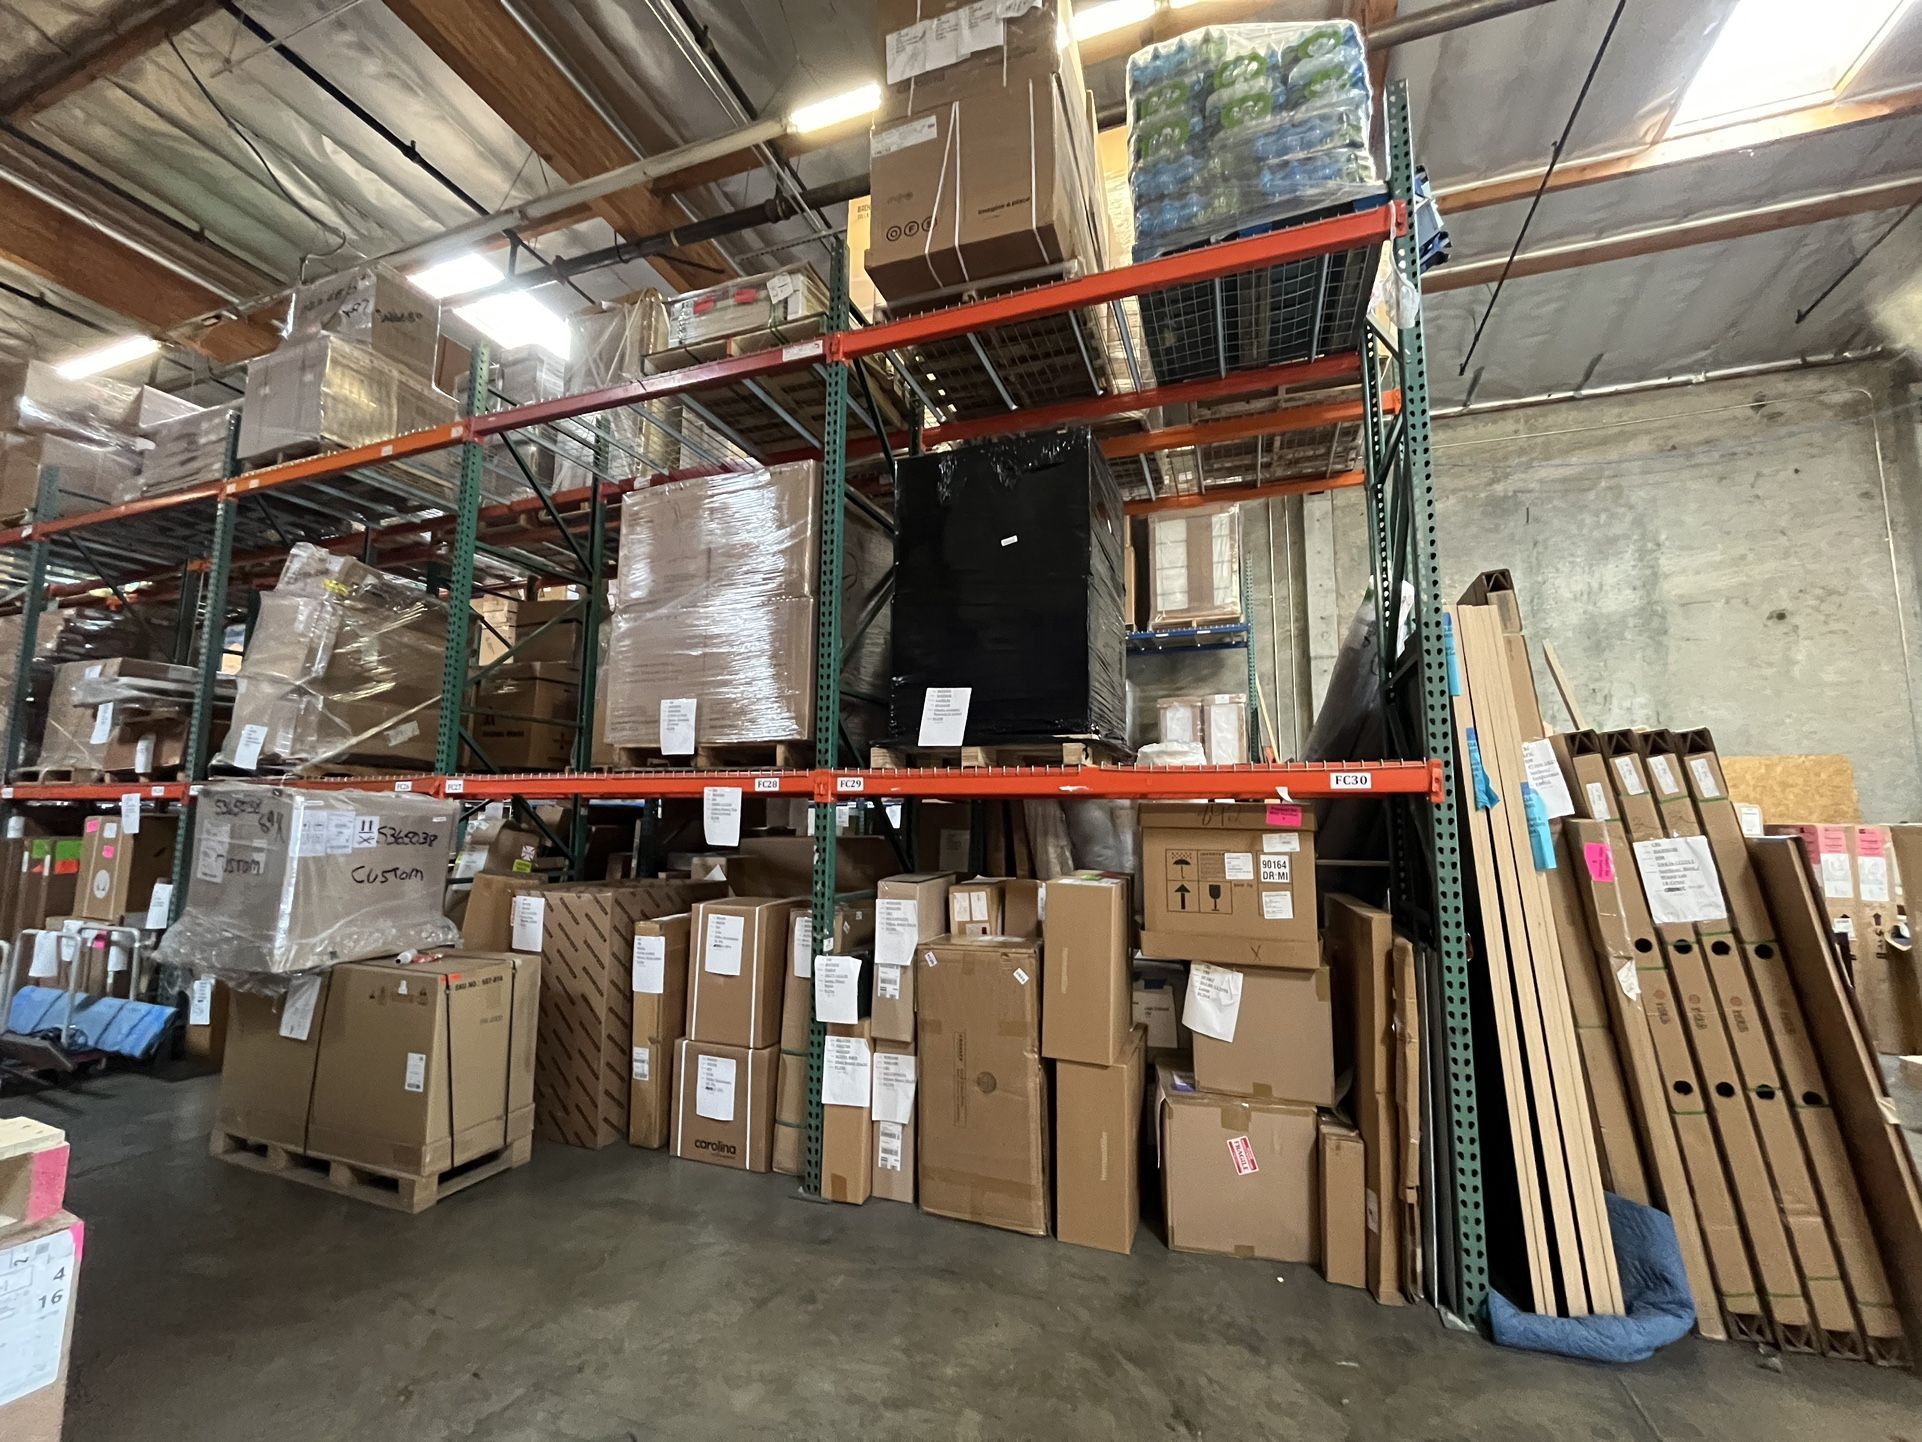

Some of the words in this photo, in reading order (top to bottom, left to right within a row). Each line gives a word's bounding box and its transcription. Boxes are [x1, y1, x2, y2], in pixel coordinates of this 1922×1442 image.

[757, 780, 778, 788] FC28
[840, 780, 861, 788] FC29
[1335, 775, 1368, 785] FC30
[1261, 859, 1287, 869] 90164
[1262, 871, 1289, 881] DR:MI
[694, 1139, 736, 1155] carolina
[1233, 1140, 1249, 1170] FRAGILE
[53, 1266, 65, 1280] 4
[38, 1289, 64, 1309] 16
